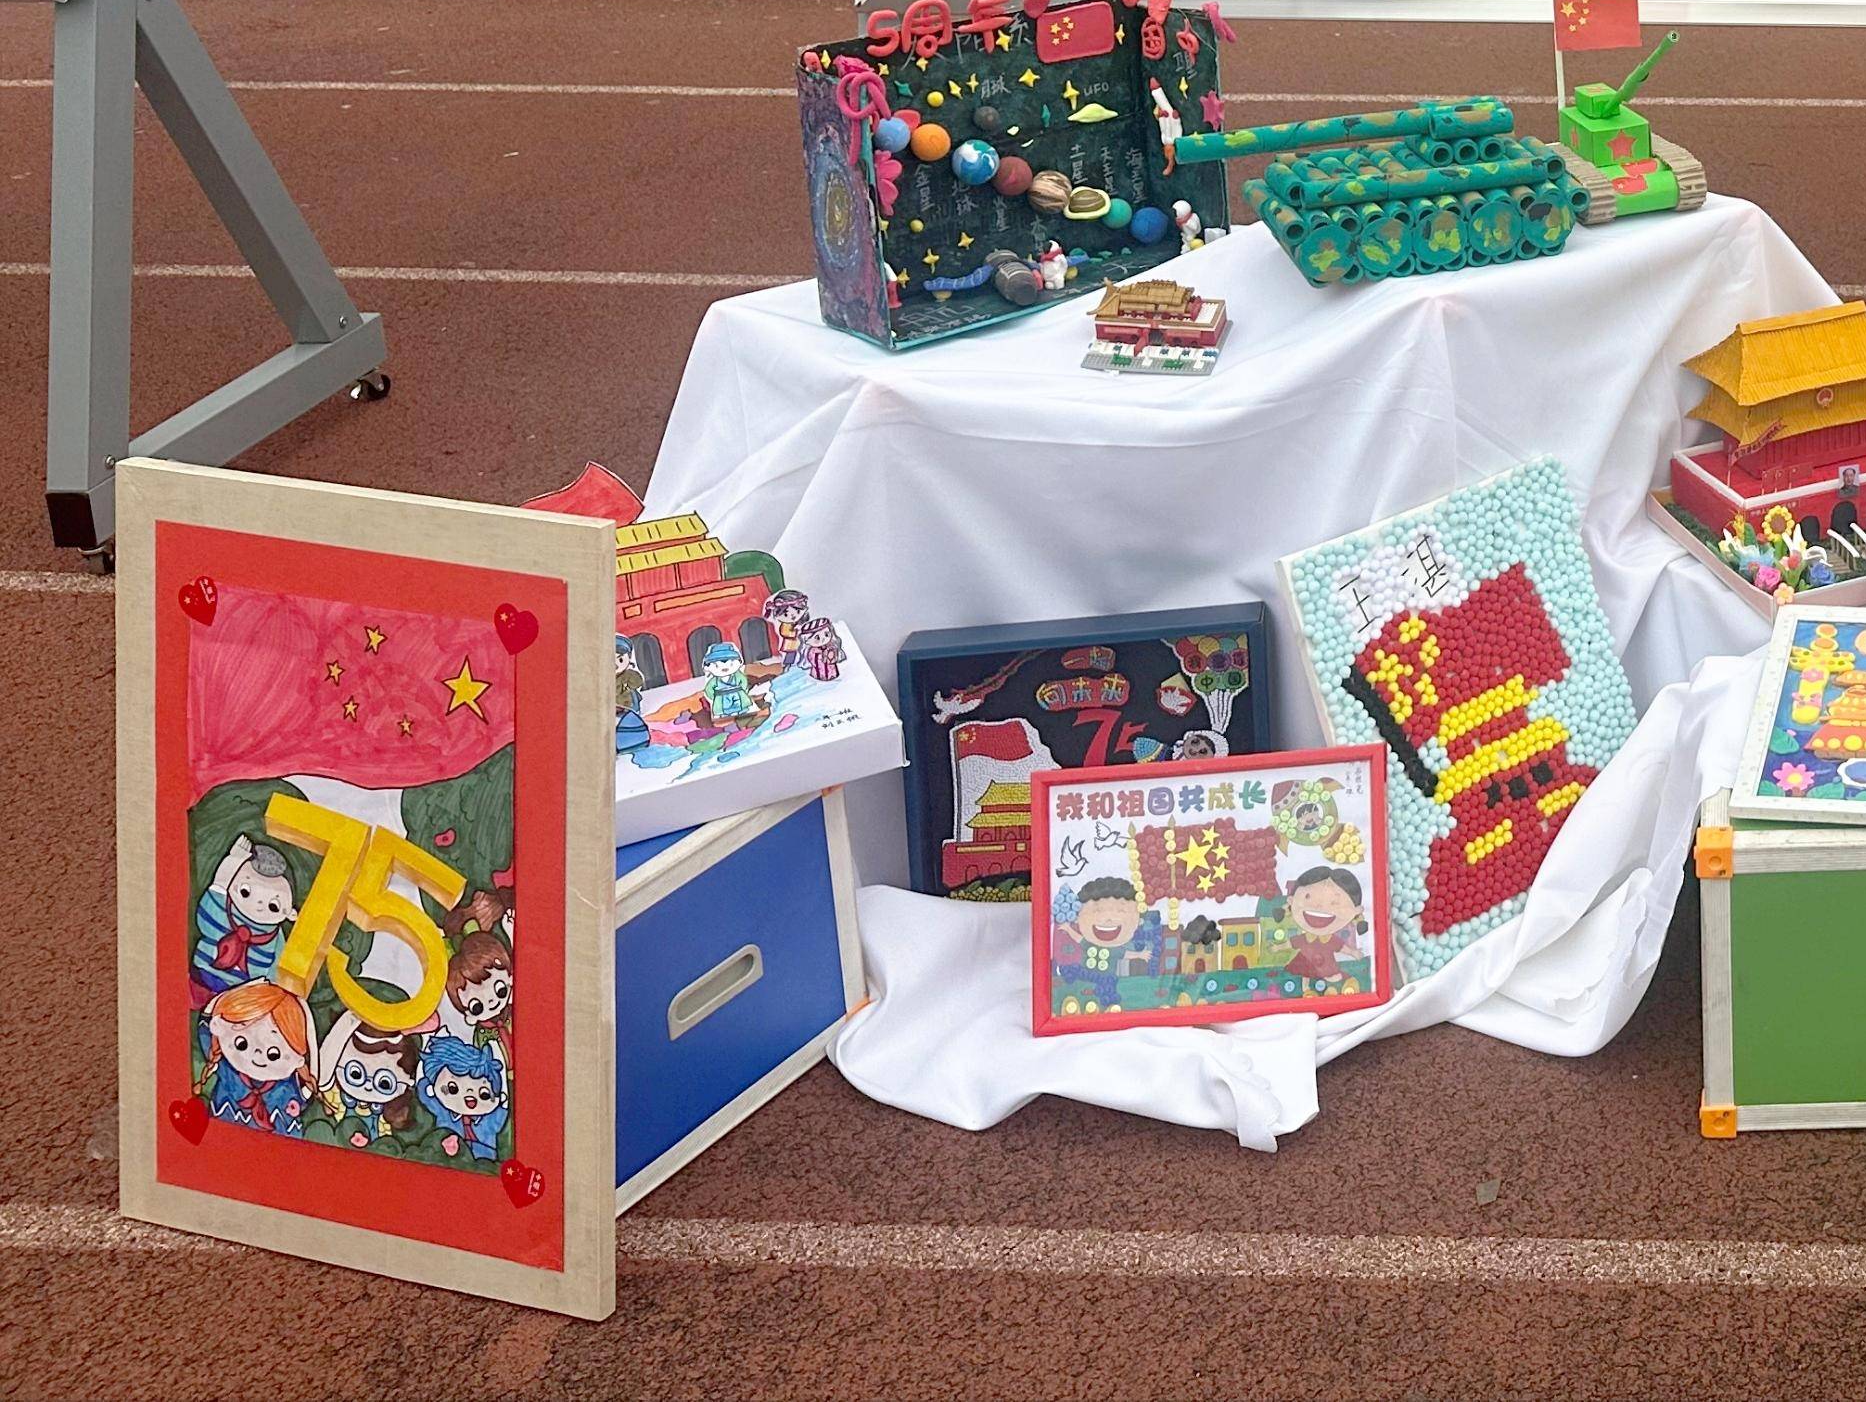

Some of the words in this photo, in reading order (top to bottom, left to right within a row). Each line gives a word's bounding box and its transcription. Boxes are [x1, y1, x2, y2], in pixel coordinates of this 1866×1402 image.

[914, 163, 934, 213] 金星
[1070, 144, 1089, 186] 土星
[1055, 779, 1267, 822] 我和祖国共成长
[264, 792, 467, 1032] 75
